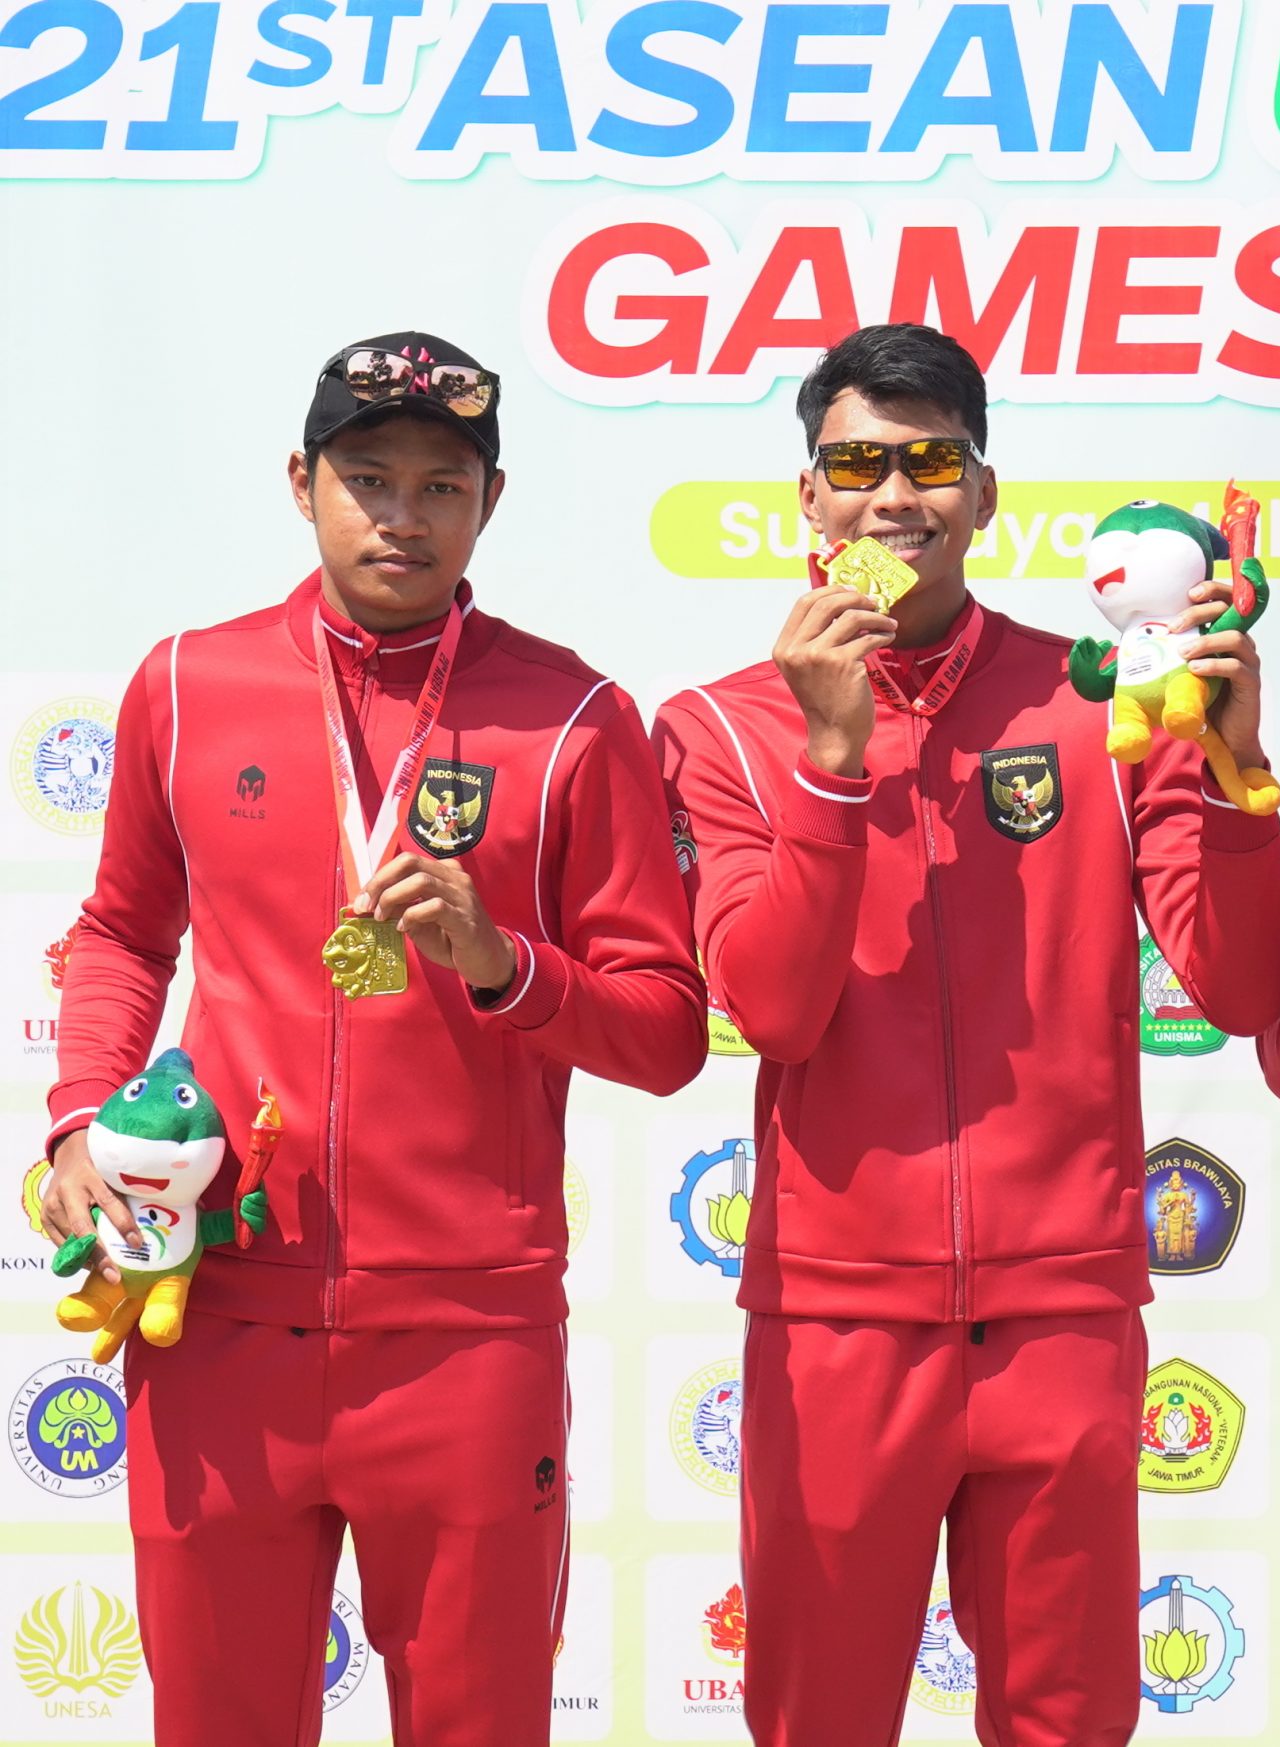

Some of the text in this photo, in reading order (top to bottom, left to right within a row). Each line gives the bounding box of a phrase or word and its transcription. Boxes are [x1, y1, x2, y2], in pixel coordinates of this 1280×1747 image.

[0, 0, 423, 150] 21ST
[417, 0, 1212, 157] ASEAN
[944, 643, 971, 684] GAMES
[427, 665, 447, 703] ASEAN
[407, 702, 435, 762] UNIVERSITY
[992, 755, 1048, 770] INDONESIA
[395, 761, 417, 799] GAMES
[427, 769, 482, 787] INDONESIA
[230, 808, 266, 819] MILLS
[711, 1031, 737, 1045] JAWA
[1154, 1032, 1203, 1042] UNISMA
[24, 1046, 57, 1055] UNIVER
[1184, 1158, 1233, 1209] BRAWIJAYA
[2, 1257, 44, 1270] KONI
[1143, 1379, 1191, 1399] BANGUNAN
[1192, 1381, 1224, 1416] NASIONAL
[13, 1378, 63, 1490] UNIVERSITAS
[61, 1448, 99, 1472] UM
[1147, 1466, 1205, 1482] JAWA TIMUR
[683, 1680, 745, 1700] UBA
[44, 1700, 112, 1719] UNESA
[553, 1697, 599, 1710] IMUR
[684, 1705, 742, 1714] UNIVERSITAS
